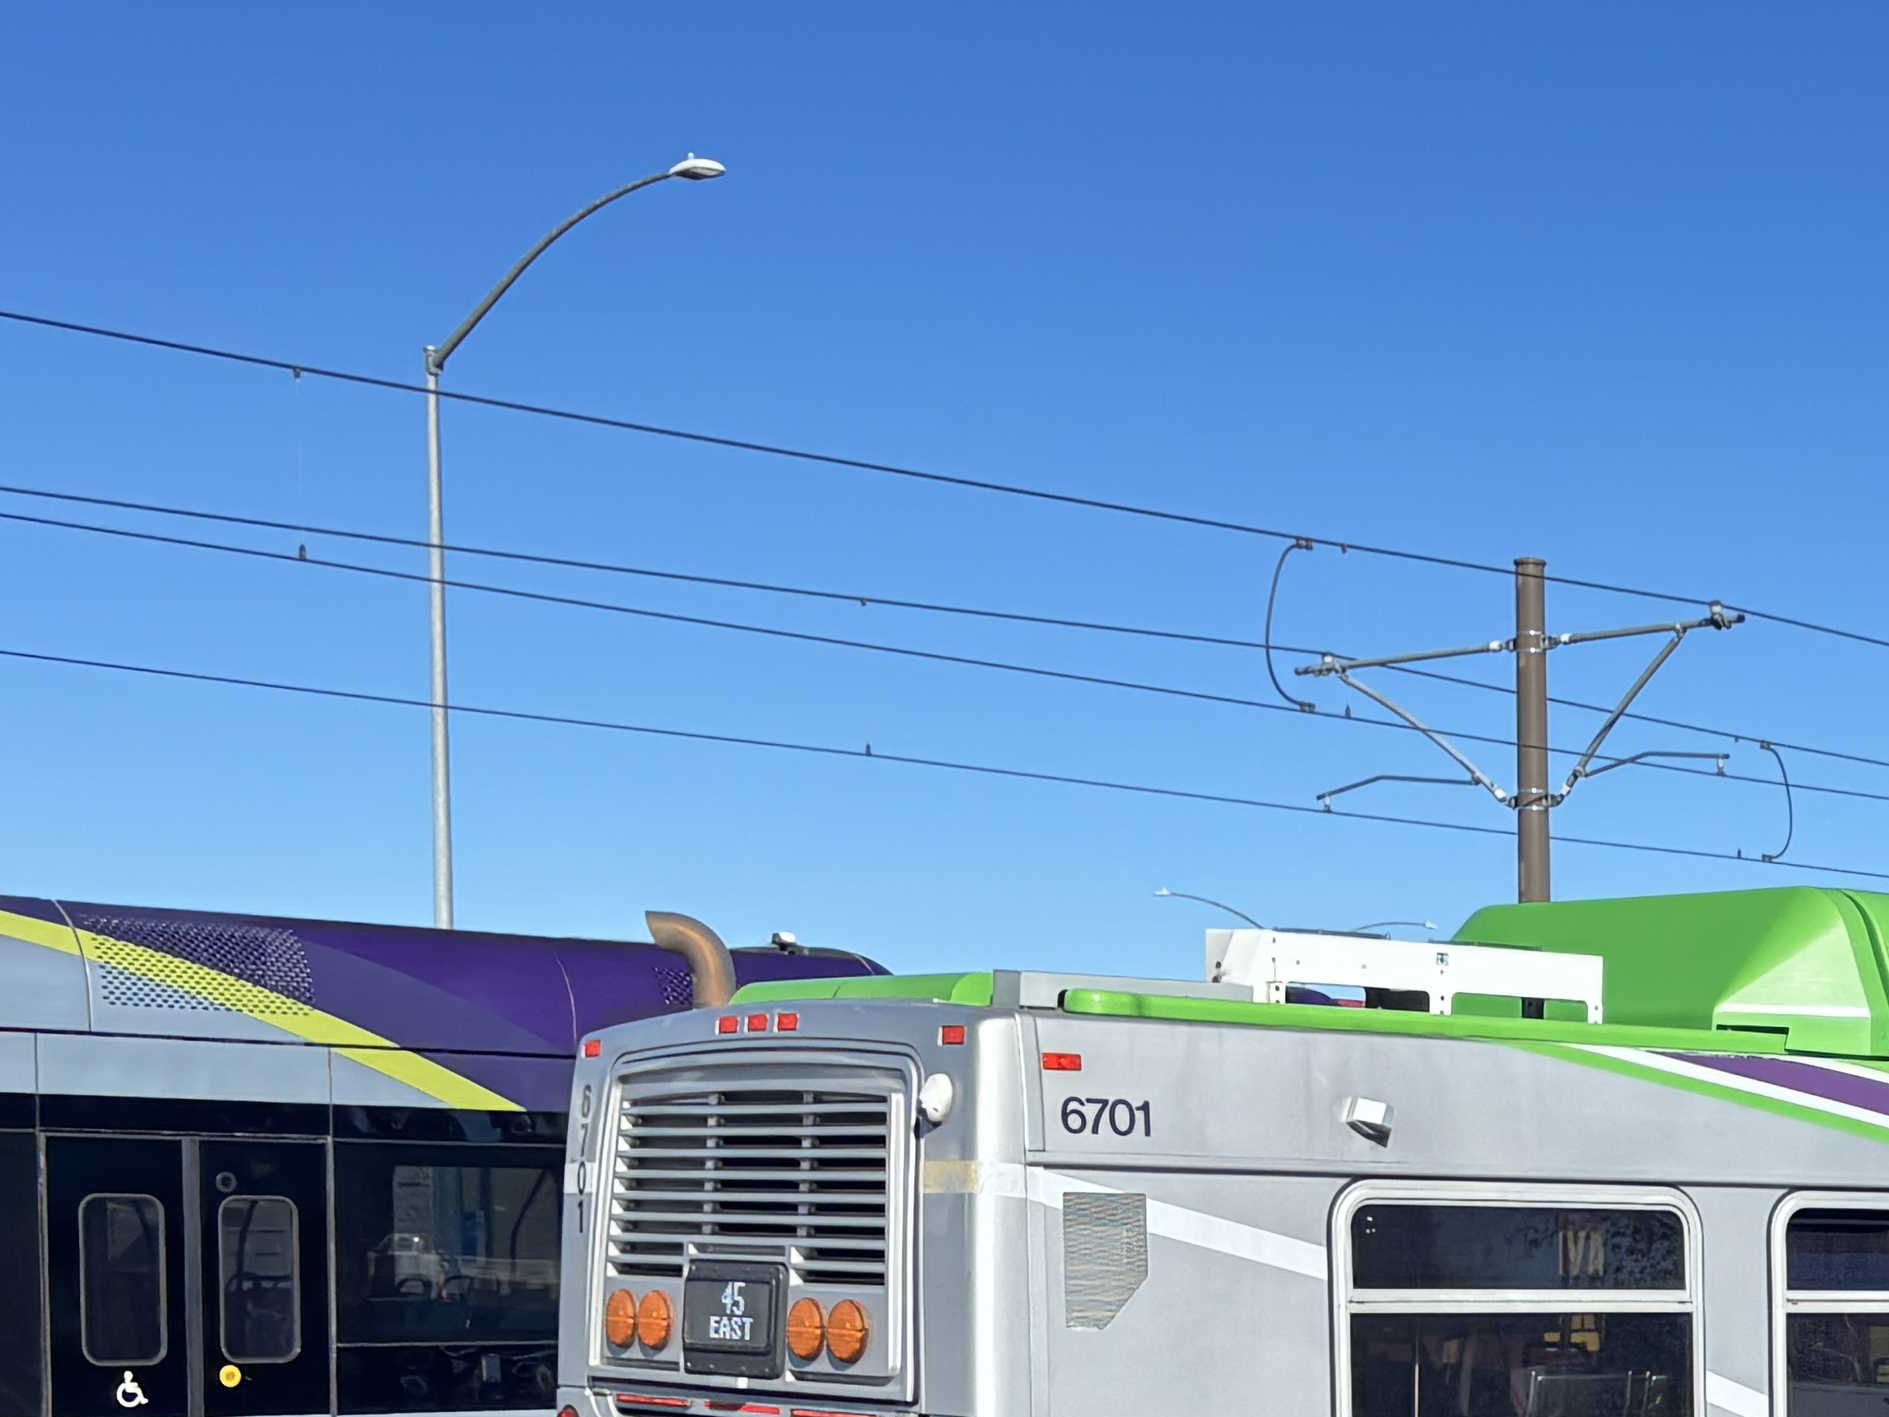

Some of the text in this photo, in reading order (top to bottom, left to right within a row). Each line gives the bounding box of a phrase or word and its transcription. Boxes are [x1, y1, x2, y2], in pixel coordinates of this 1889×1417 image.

[1061, 1096, 1151, 1137] 6701
[721, 1281, 746, 1315] 45
[709, 1315, 754, 1341] EAST
